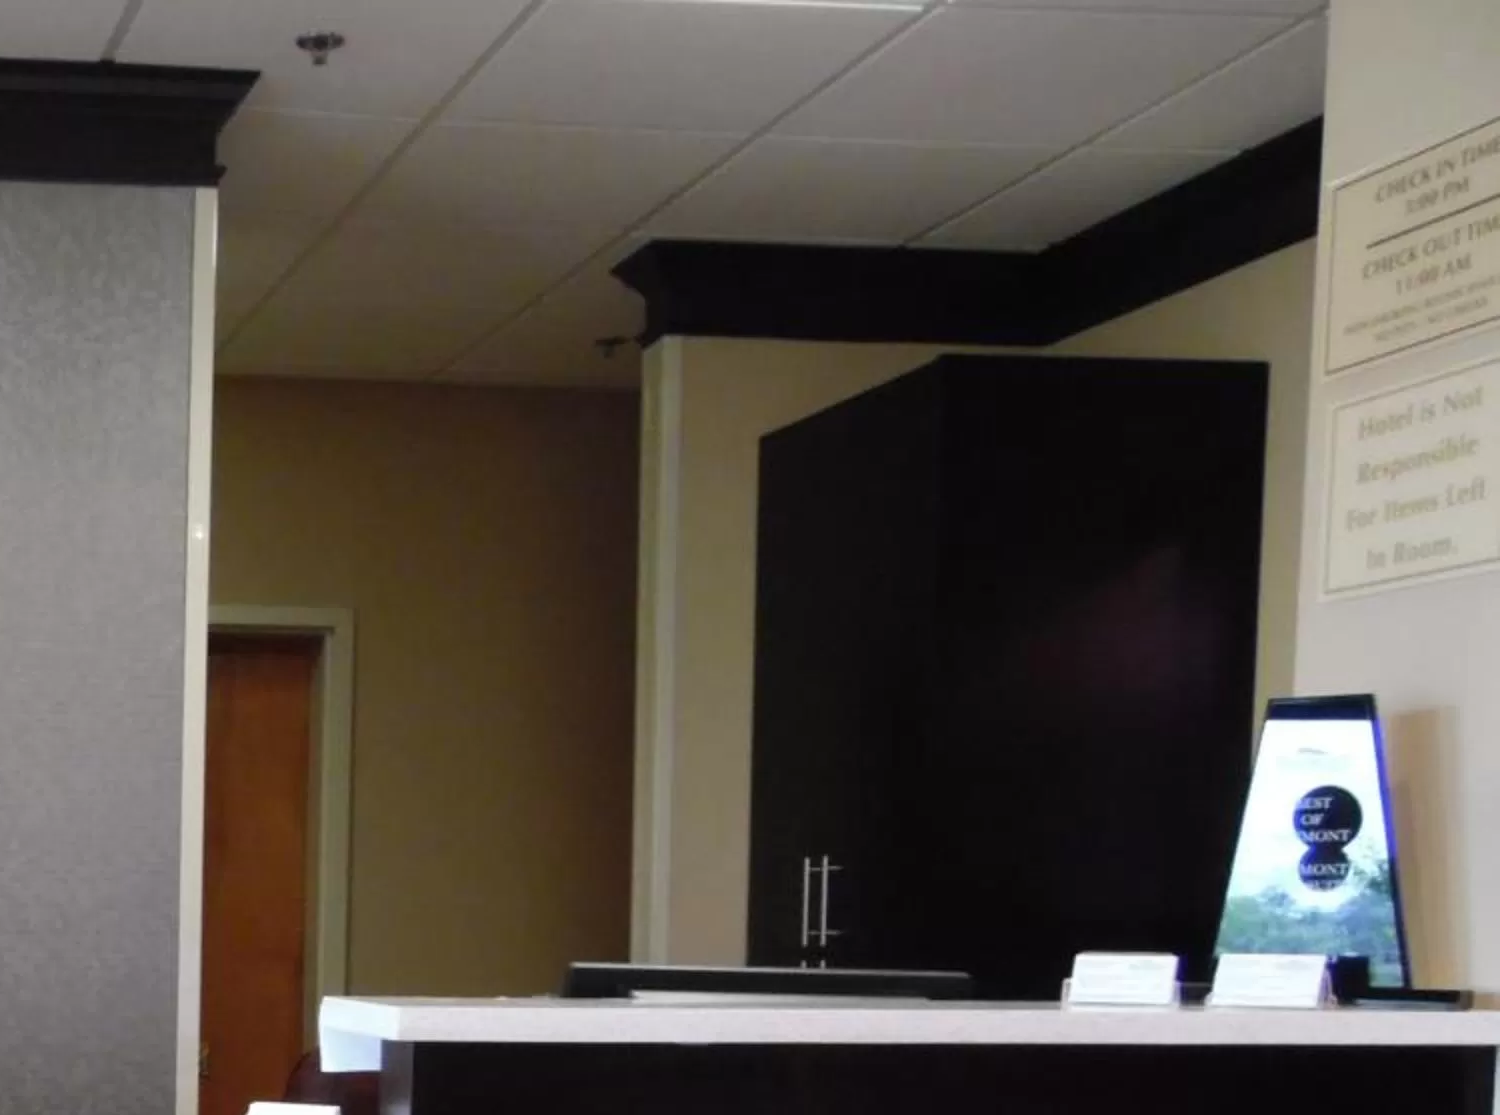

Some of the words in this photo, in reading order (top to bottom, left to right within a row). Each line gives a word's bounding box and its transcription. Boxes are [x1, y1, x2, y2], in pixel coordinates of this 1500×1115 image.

[1374, 167, 1430, 203] CHECK
[1436, 159, 1457, 178] IN
[1443, 176, 1469, 201] PM
[1362, 245, 1418, 280] CHECK
[1422, 227, 1461, 257] OUT
[1466, 213, 1500, 241] TIM
[1444, 252, 1472, 278] AM
[1358, 404, 1413, 440] Hotel
[1419, 403, 1436, 424] is
[1443, 386, 1484, 416] Not
[1356, 434, 1481, 485] Responsible
[1346, 508, 1377, 531] For
[1382, 496, 1438, 523] Items
[1446, 475, 1486, 506] Left
[1299, 829, 1350, 842] MONT
[1301, 813, 1324, 825] OF
